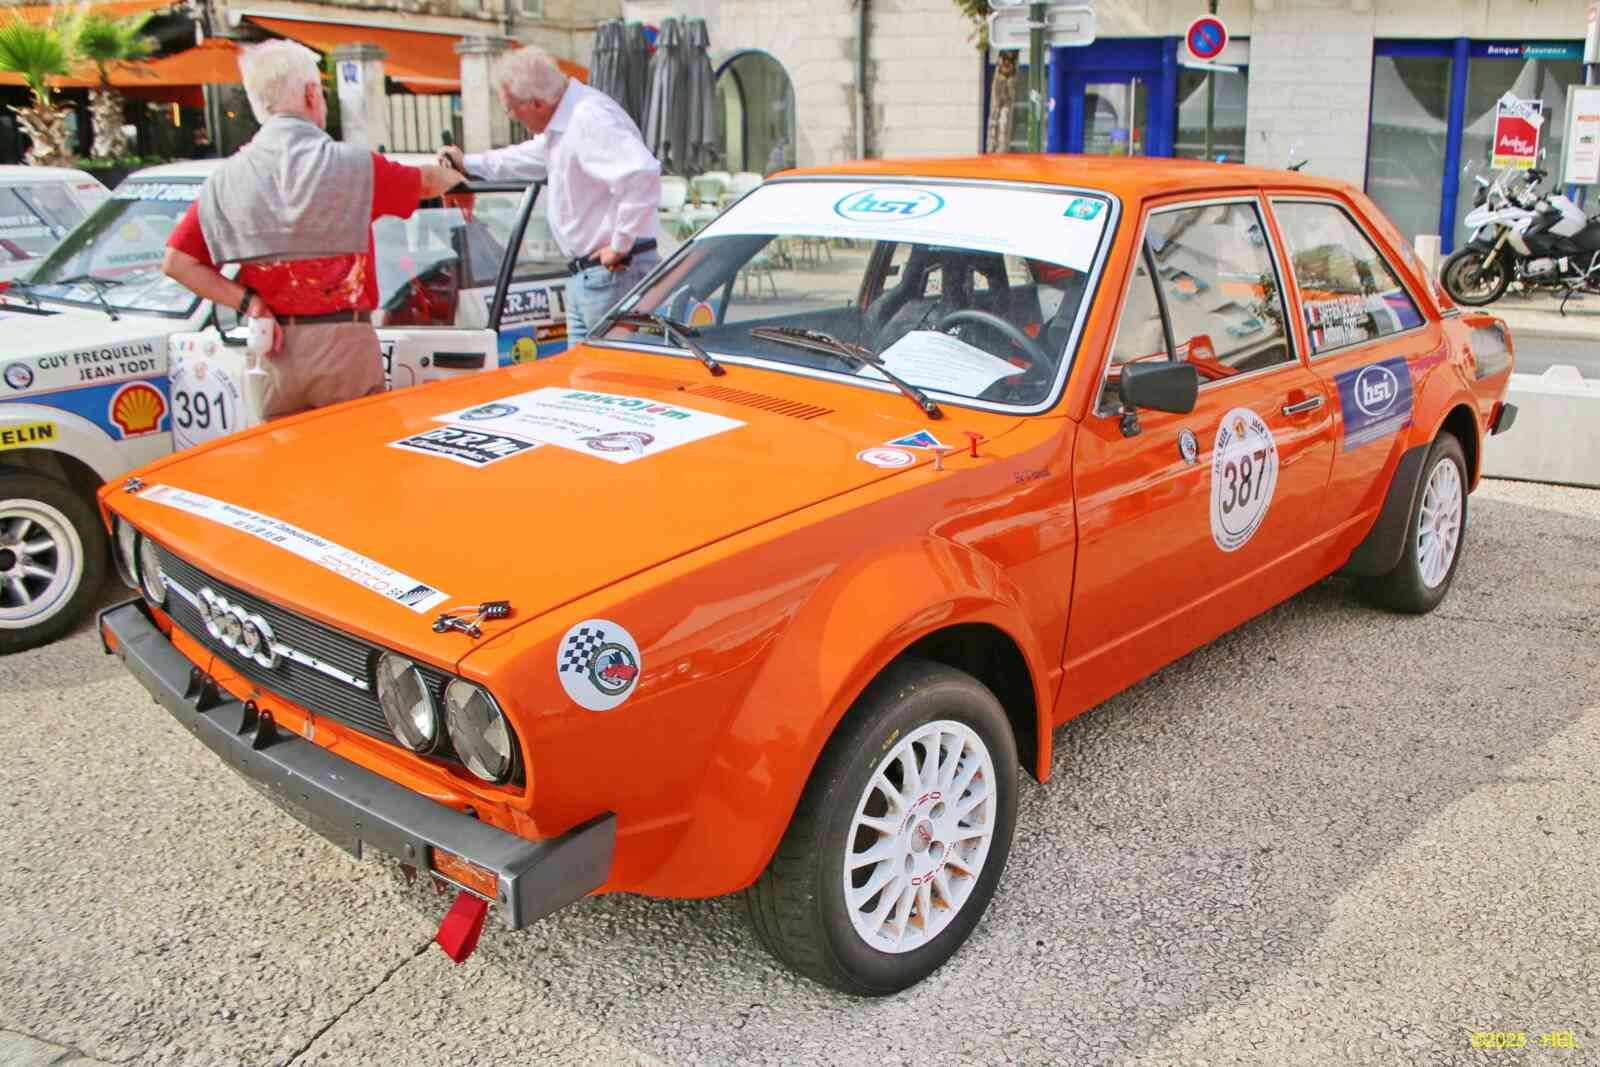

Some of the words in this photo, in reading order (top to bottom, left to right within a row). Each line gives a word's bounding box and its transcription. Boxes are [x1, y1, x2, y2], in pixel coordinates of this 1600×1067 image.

[1487, 45, 1519, 55] Banque
[38, 354, 71, 370] GUY
[73, 343, 154, 365] FREQUELIN
[79, 365, 116, 381] JEAN
[120, 359, 157, 374] TODT
[175, 391, 228, 429] 391
[1221, 448, 1268, 515] 387
